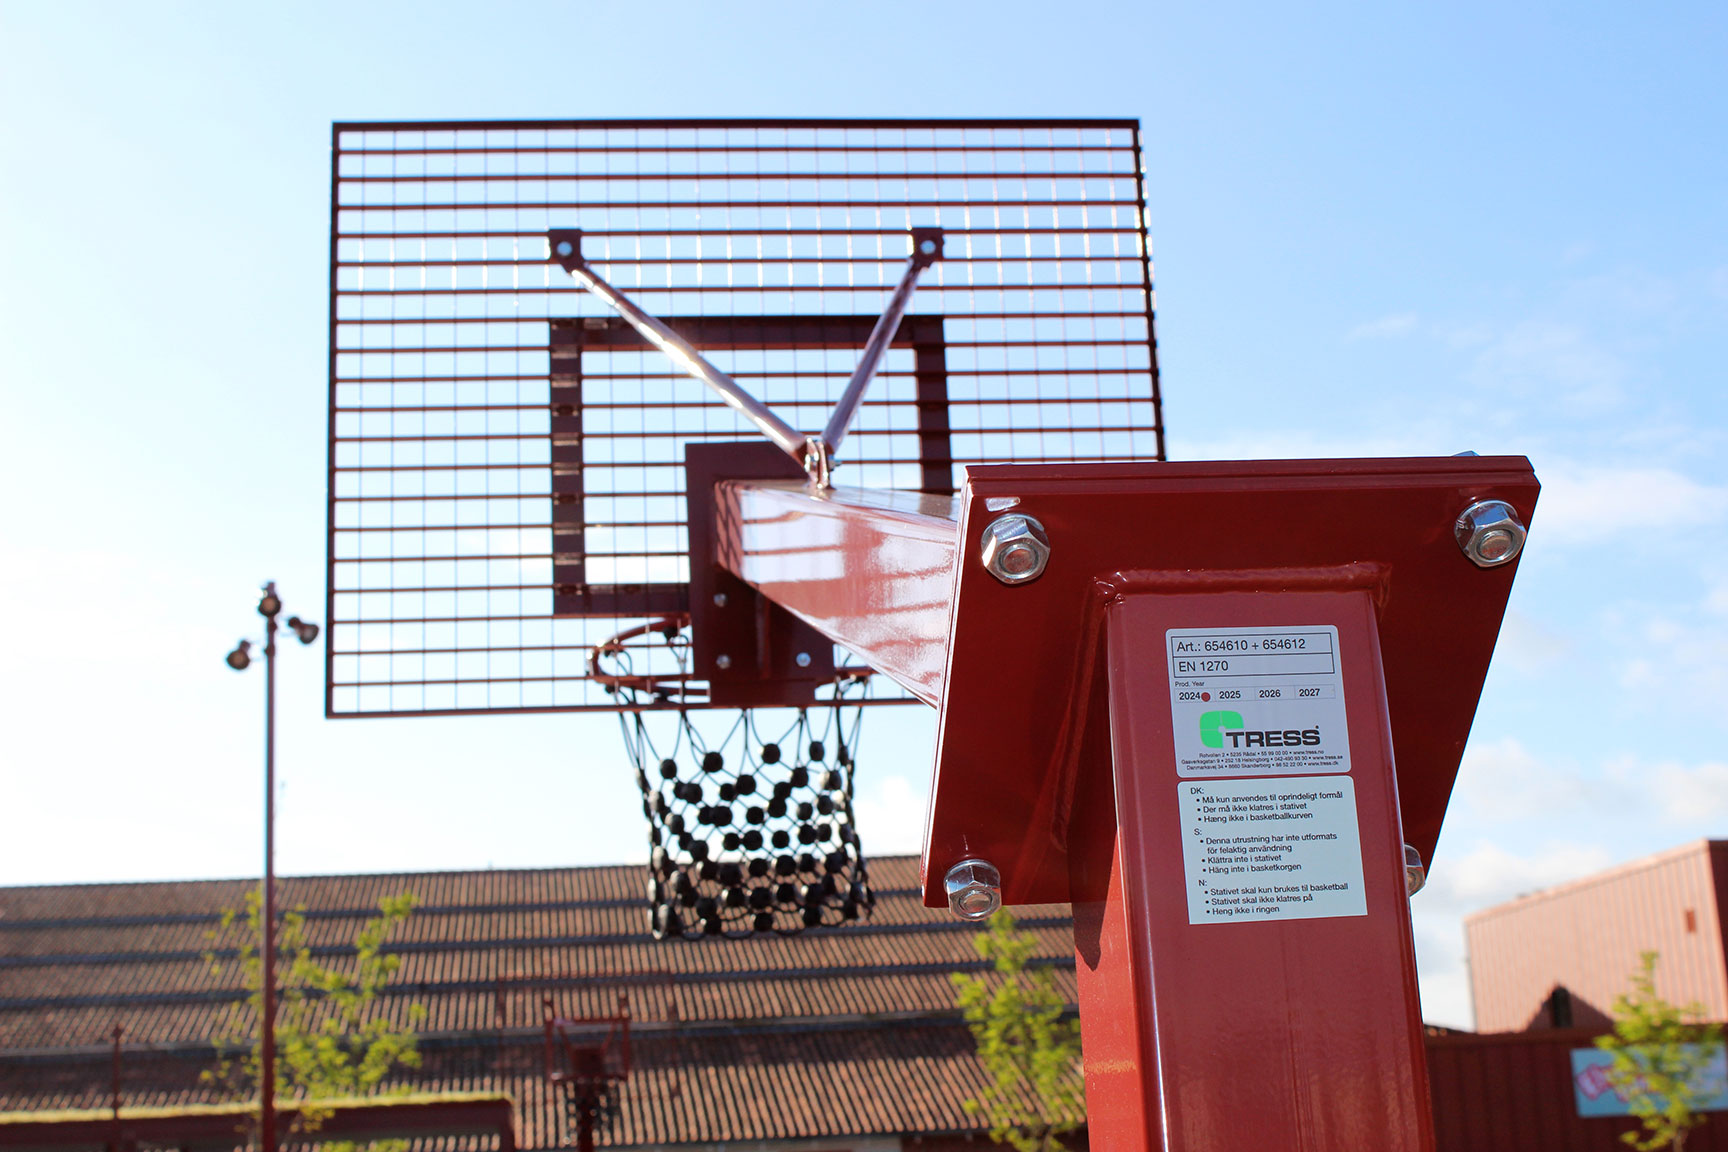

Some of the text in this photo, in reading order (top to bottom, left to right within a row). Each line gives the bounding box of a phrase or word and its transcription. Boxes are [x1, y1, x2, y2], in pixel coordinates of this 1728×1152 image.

[1176, 641, 1200, 652] Art.:
[1204, 640, 1248, 652] 654610
[1262, 638, 1306, 650] 654612
[1178, 660, 1228, 672] EN 1270
[1179, 688, 1320, 700] 2024 2025 2026 2027
[1226, 730, 1320, 748] TRESS
[1232, 794, 1268, 802] anvendes
[1278, 792, 1318, 801] oprindeligt
[1319, 791, 1342, 799] formål
[1280, 802, 1307, 810] stativet
[1204, 816, 1227, 824] Hæng
[1250, 812, 1313, 821] basketballkurven
[1232, 836, 1270, 844] utrustning
[1302, 832, 1338, 840] utformats
[1220, 846, 1247, 854] felaktig
[1248, 844, 1292, 852] användning
[1208, 866, 1229, 874] Häng
[1250, 864, 1302, 872] basketkorgen
[1210, 888, 1240, 896] Stativet
[1310, 882, 1348, 891] basketball
[1212, 897, 1240, 905] Stativet
[1242, 896, 1257, 904] skal
[1303, 893, 1314, 902] på
[1212, 908, 1233, 916] Heng
[1256, 905, 1280, 914] ringen
